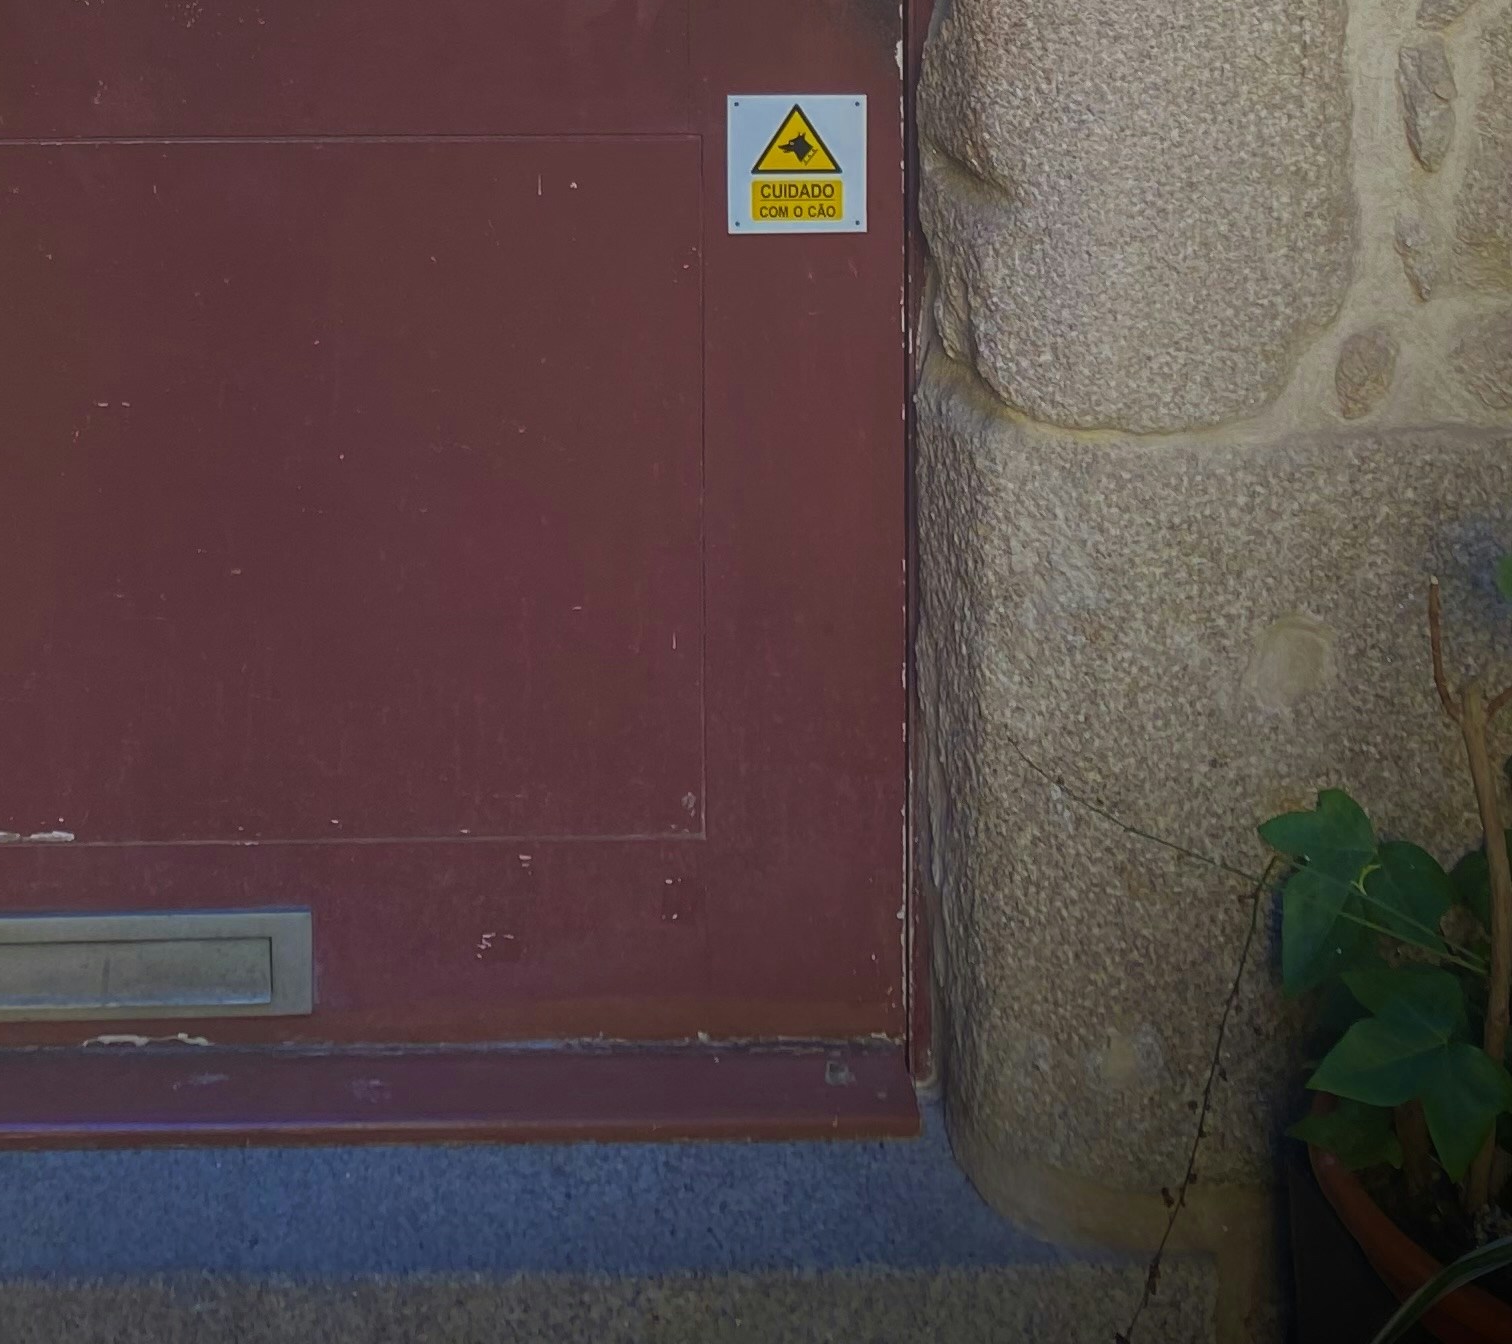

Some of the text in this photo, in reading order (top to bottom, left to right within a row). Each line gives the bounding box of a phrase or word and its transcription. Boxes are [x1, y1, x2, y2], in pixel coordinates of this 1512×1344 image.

[760, 183, 835, 199] CUIDADO
[759, 203, 836, 218] COM O CÃO
